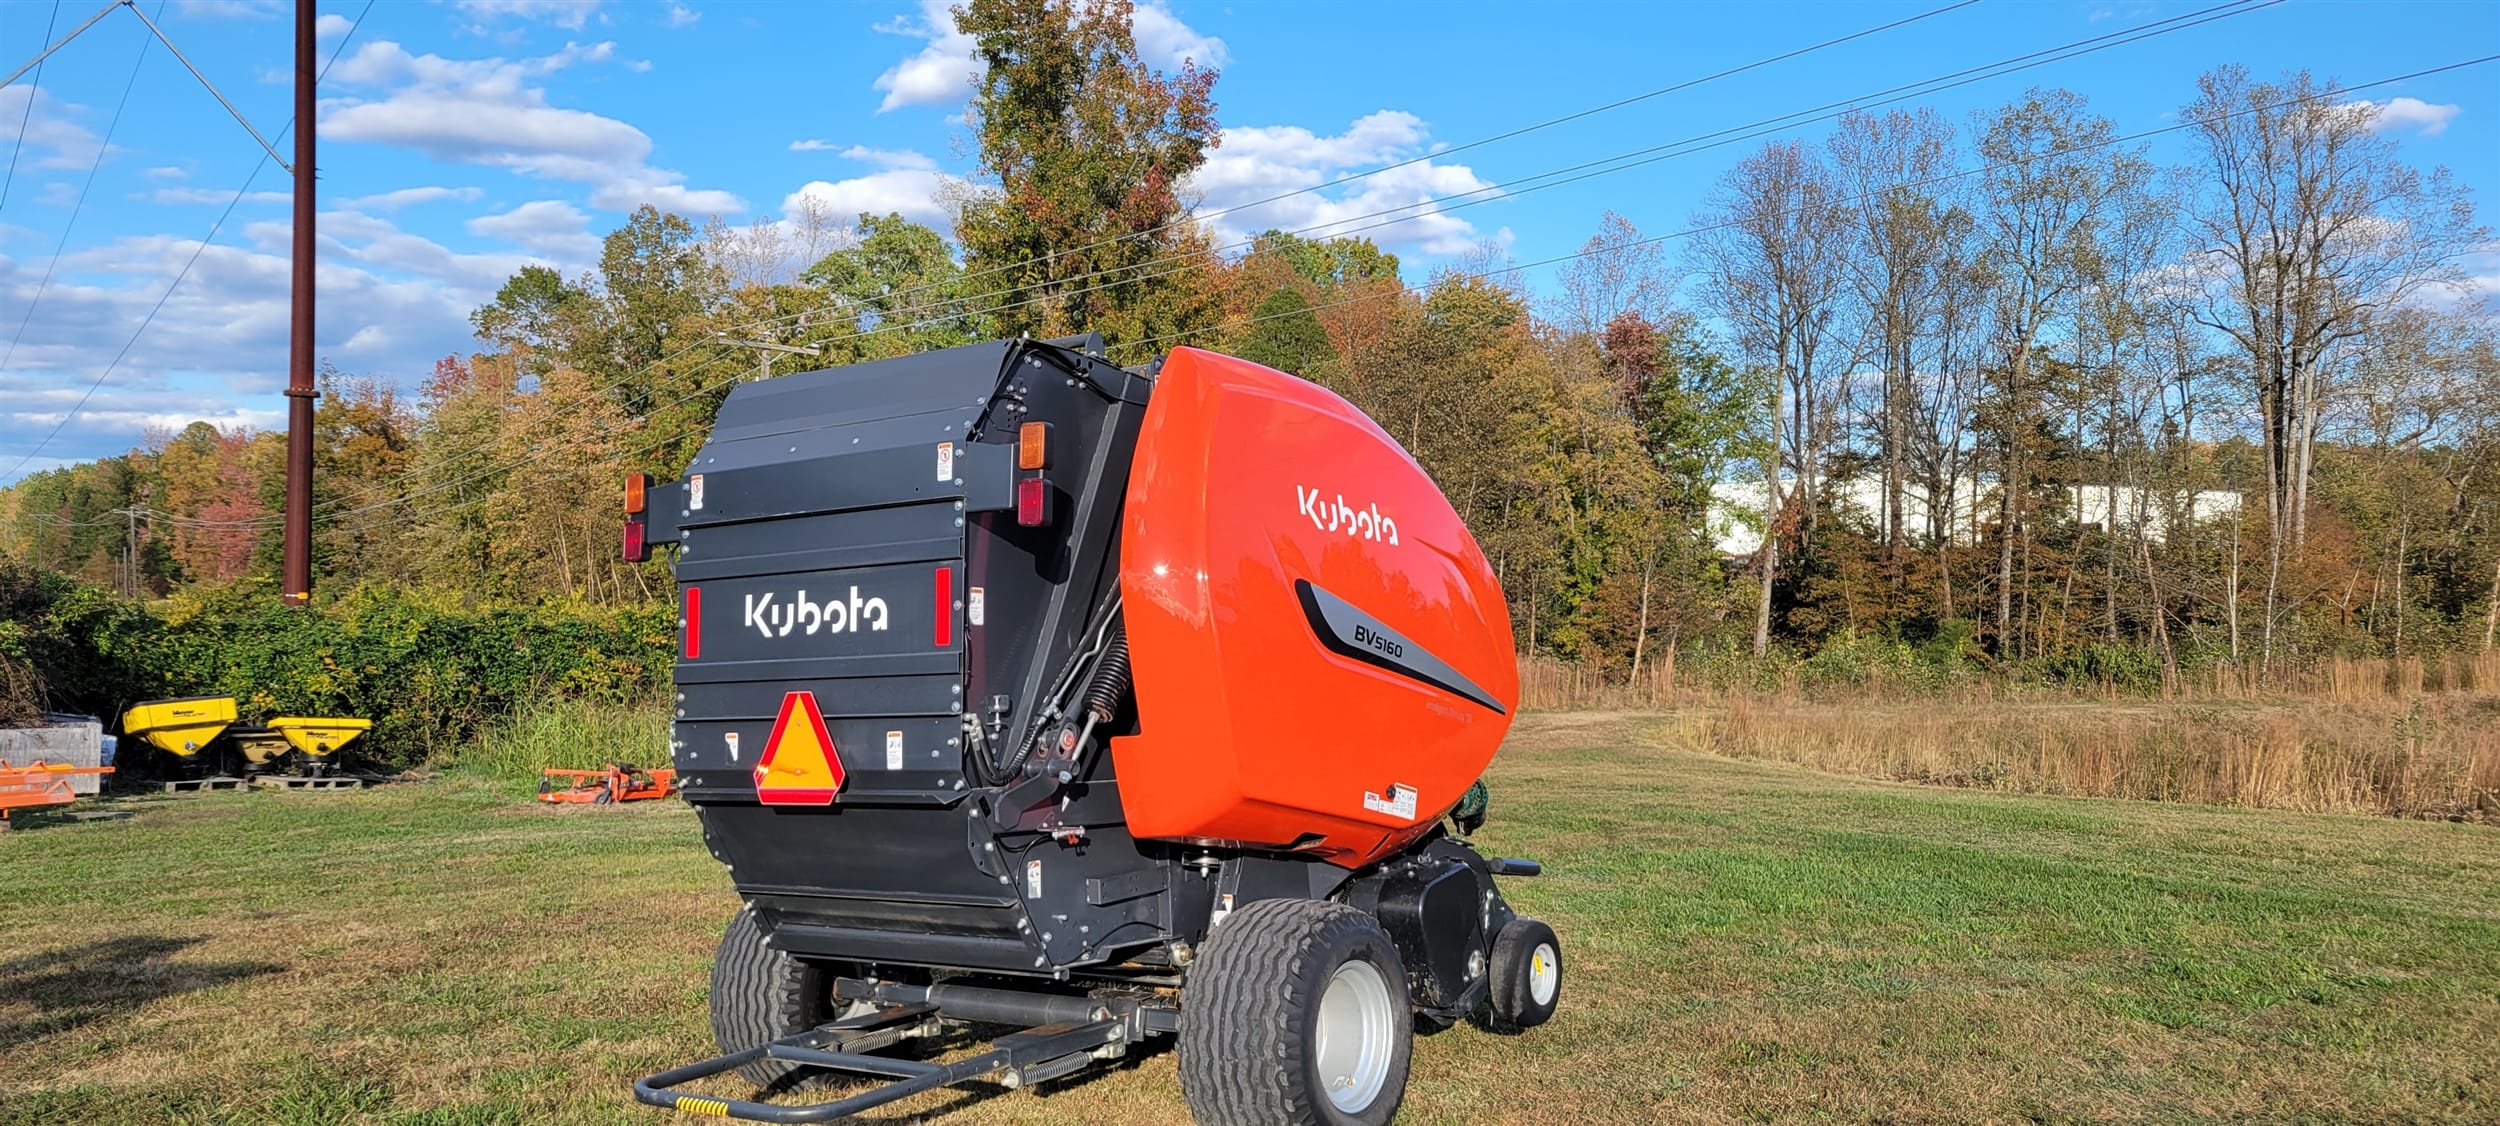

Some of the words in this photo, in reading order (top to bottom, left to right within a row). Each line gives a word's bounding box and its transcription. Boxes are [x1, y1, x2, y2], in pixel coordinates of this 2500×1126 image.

[1297, 485, 1399, 546] Kubota
[745, 585, 888, 638] Kubota
[1354, 624, 1403, 658] BV5160
